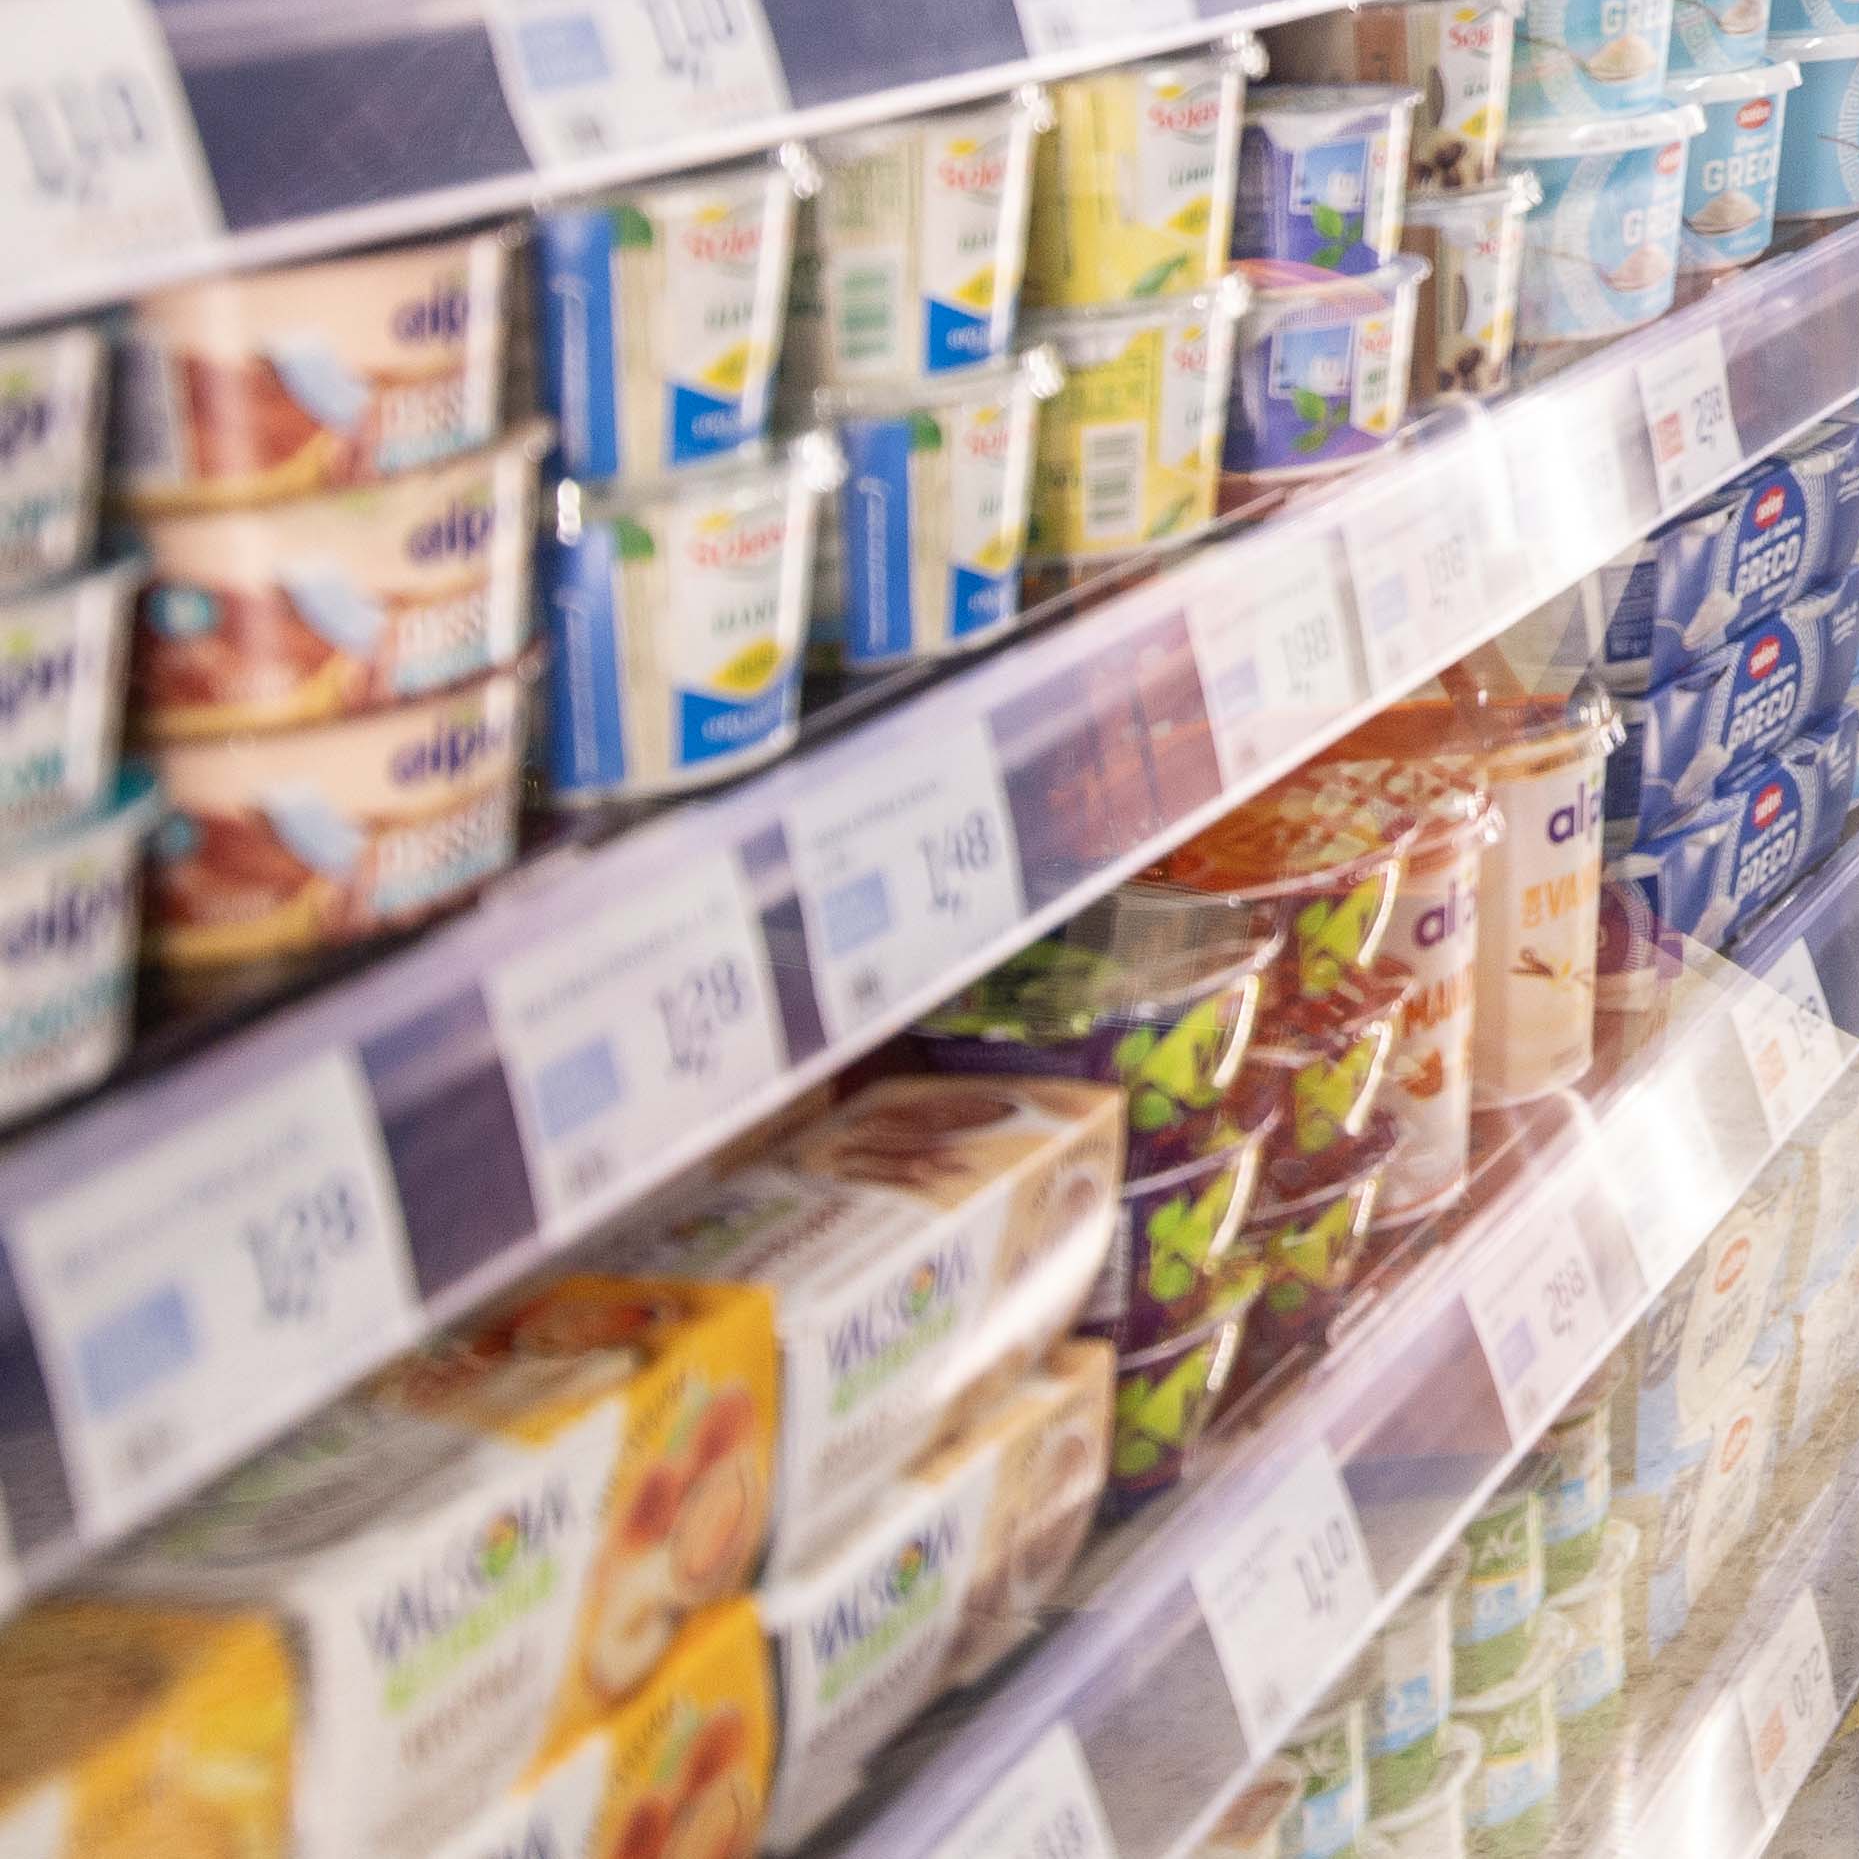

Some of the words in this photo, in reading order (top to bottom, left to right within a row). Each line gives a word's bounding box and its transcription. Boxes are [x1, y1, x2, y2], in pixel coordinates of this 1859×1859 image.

[1702, 146, 1779, 193] GREC
[1734, 534, 1801, 602] GRECO
[1727, 682, 1798, 751] GRECO
[1734, 829, 1799, 900] GRECO
